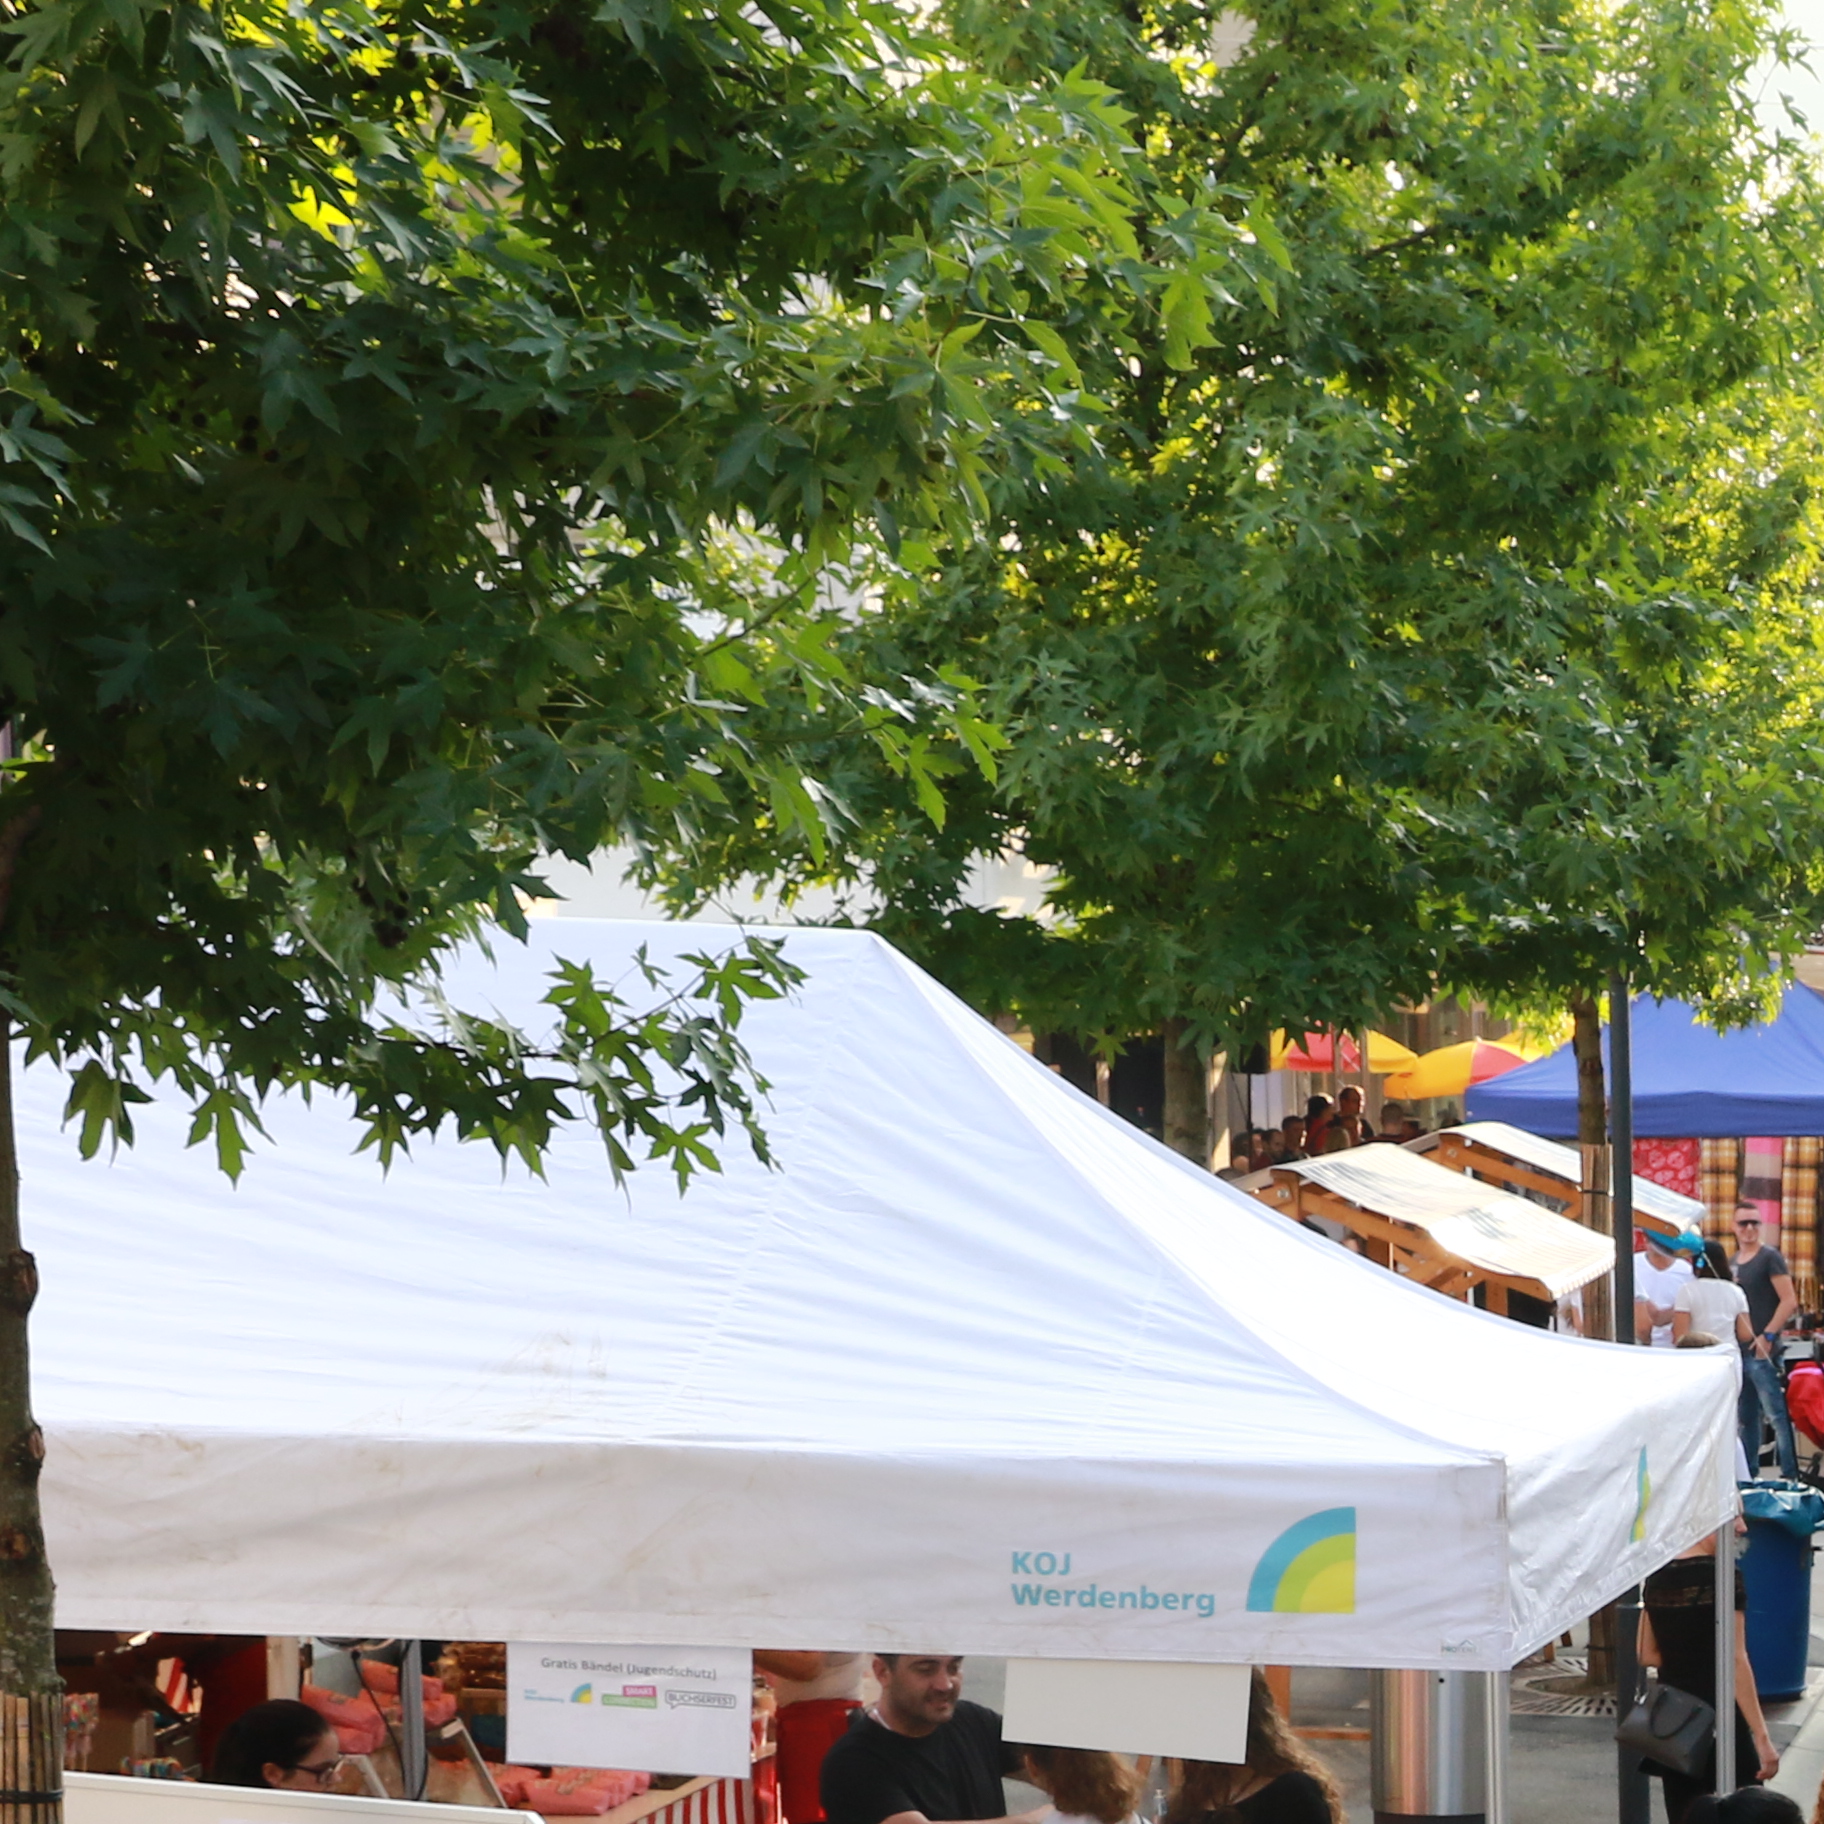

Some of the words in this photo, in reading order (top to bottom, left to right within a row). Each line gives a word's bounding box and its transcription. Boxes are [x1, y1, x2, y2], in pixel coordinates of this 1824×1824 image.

[1011, 1551, 1072, 1577] KOJ
[1011, 1583, 1216, 1619] Werdenberg
[541, 1657, 578, 1671] Gratis
[581, 1660, 624, 1674] Bändel
[626, 1663, 718, 1682] (Jugendschutz)
[668, 1692, 734, 1706] BUCHSERFEST
